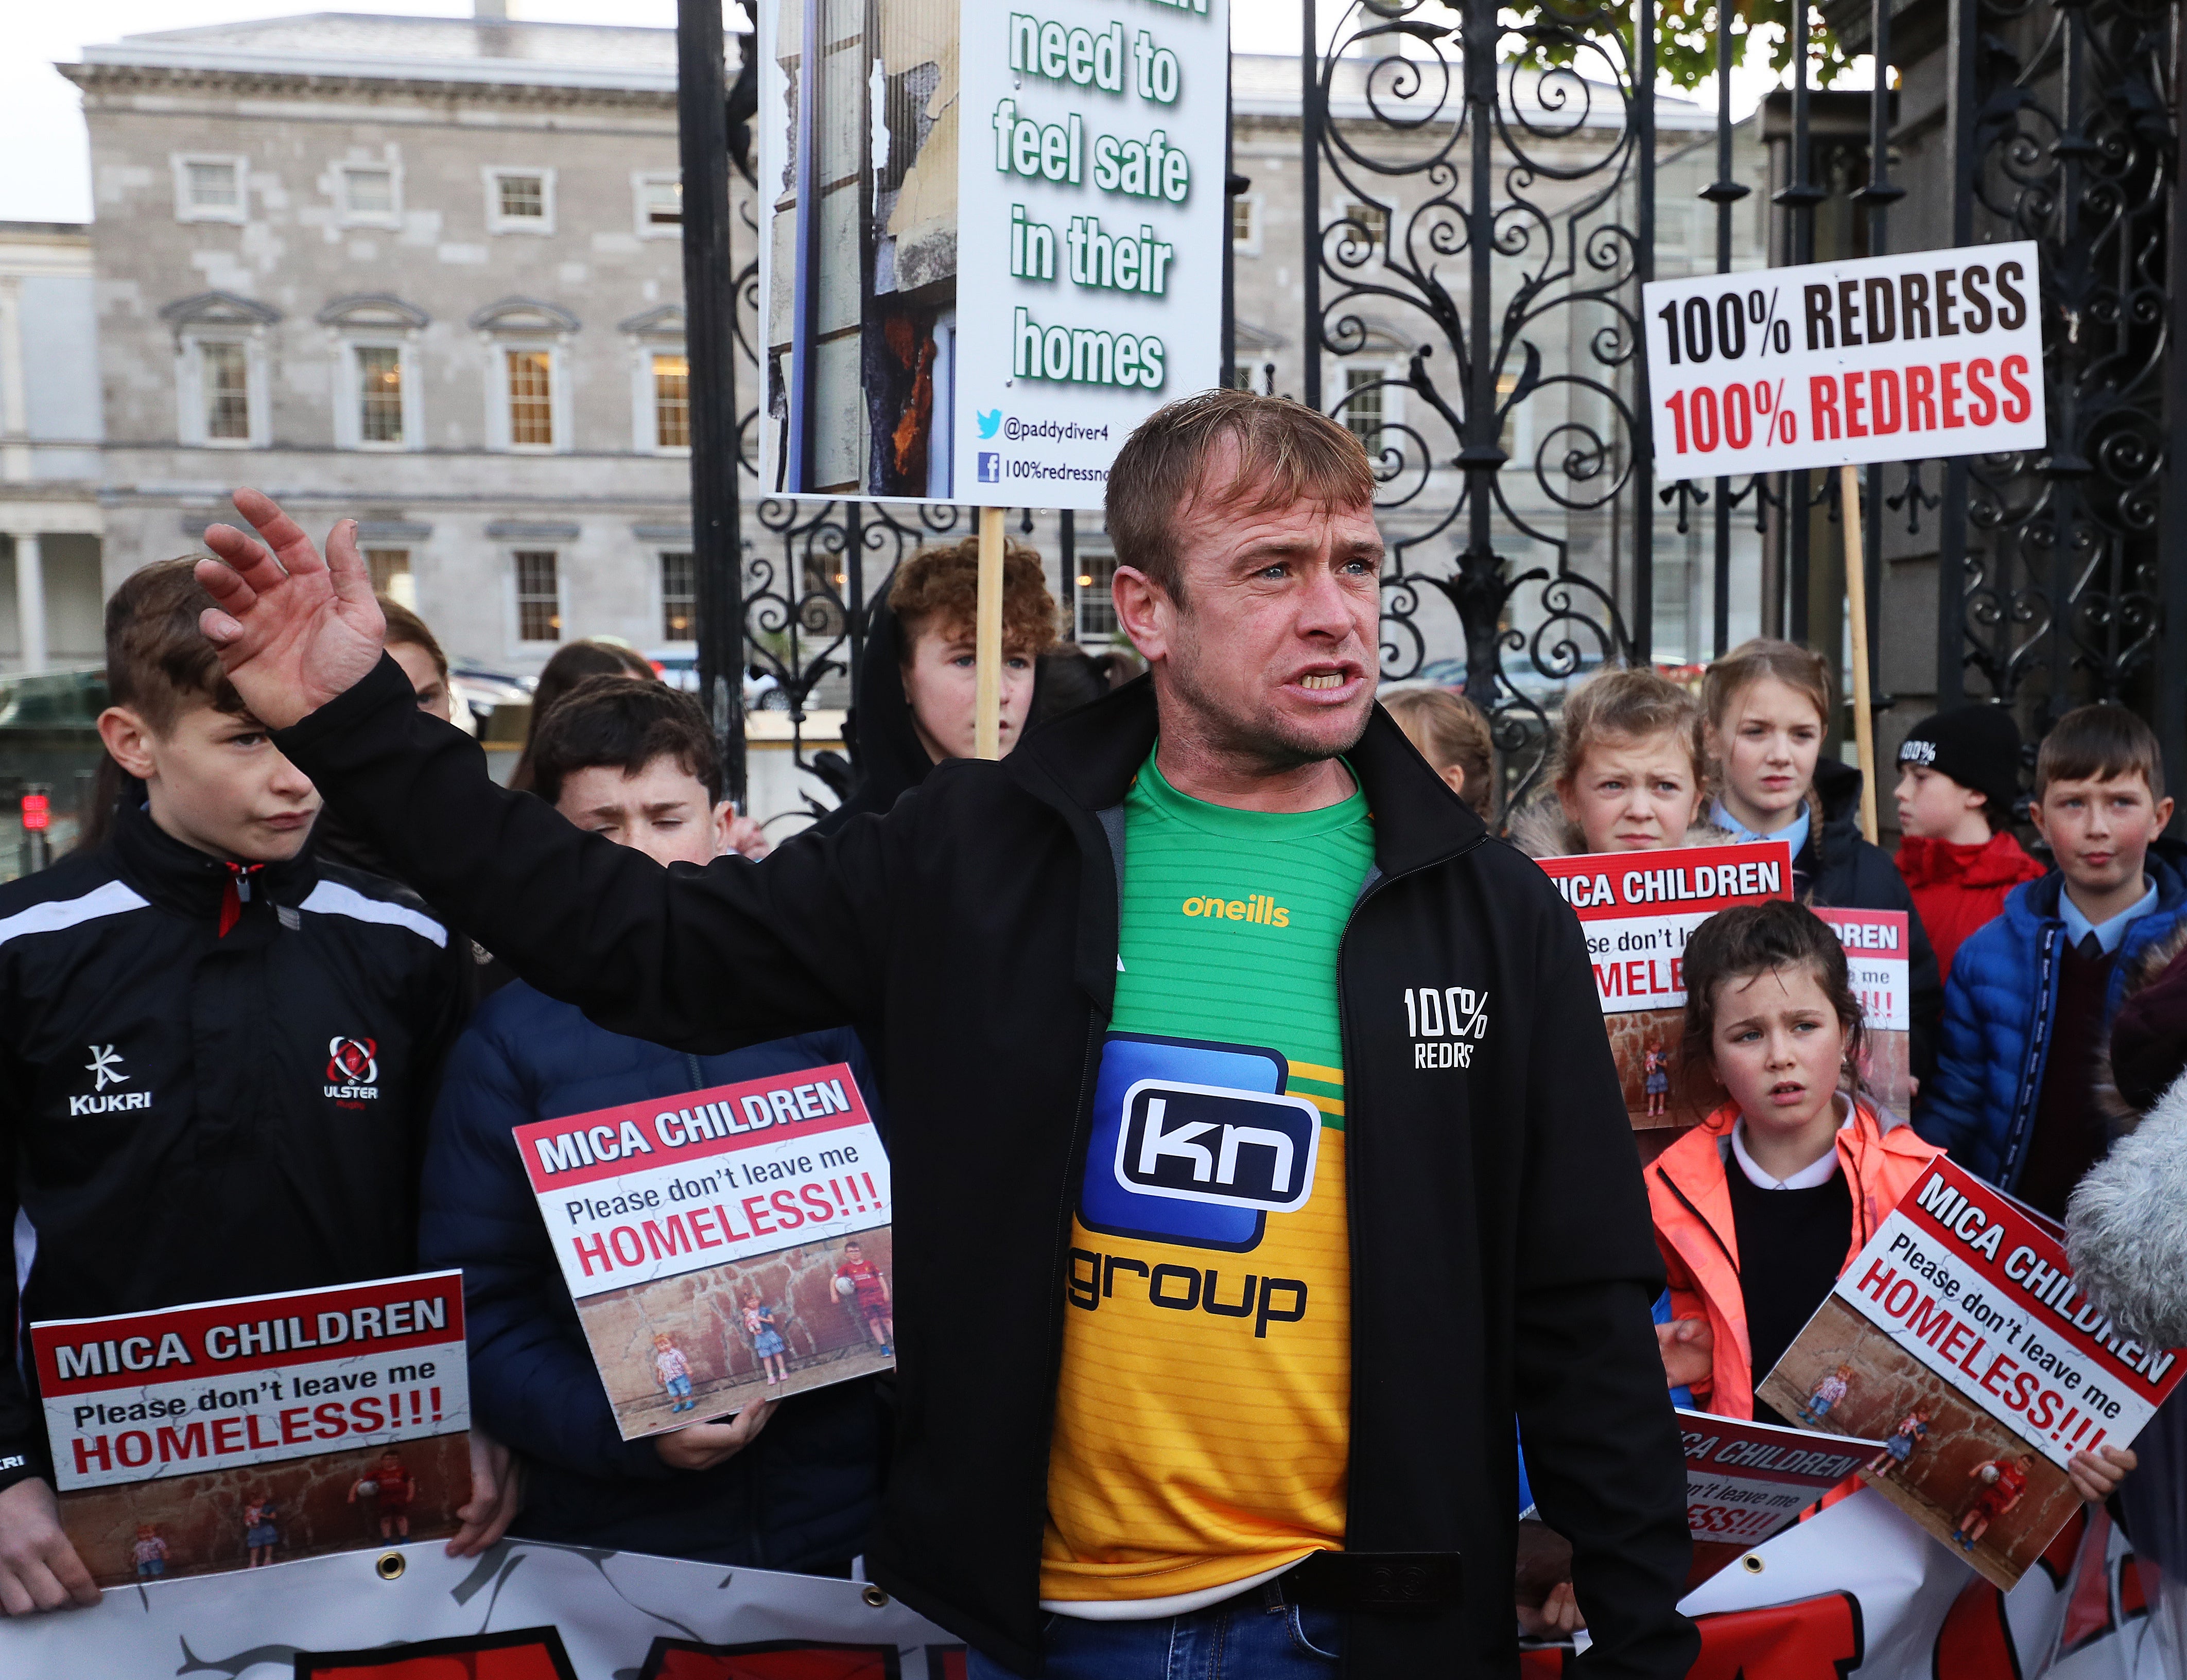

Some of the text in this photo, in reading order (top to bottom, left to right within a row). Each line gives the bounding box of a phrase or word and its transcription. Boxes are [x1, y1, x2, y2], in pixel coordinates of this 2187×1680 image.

[1010, 12, 1179, 103] need to
[994, 99, 1189, 202] feel safe
[1011, 204, 1172, 295] in their
[1014, 307, 1164, 390] homes
[1659, 261, 2026, 364] 100% REDRESS
[1004, 417, 1108, 443] @paddydiver4
[1665, 354, 2032, 454] 100% REDRESS
[1551, 861, 1780, 907] ICA CHILDREN
[1618, 929, 1673, 951] don't
[1862, 971, 1889, 984] me
[1404, 987, 1488, 1039] 100%
[69, 1091, 152, 1116] KUKRI
[324, 1085, 378, 1099] ULSTER
[534, 1079, 850, 1175] MICA CHILDREN
[566, 1146, 860, 1227] Please don't leave me
[1138, 1098, 1294, 1193] kn
[571, 1172, 883, 1277] HOMELESS!!!
[1916, 1171, 2006, 1263] MICA
[1068, 1247, 1307, 1338] group
[1890, 1233, 2121, 1420] Please don't leave me
[55, 1297, 447, 1380] MICA CHILDREN
[1856, 1258, 2107, 1454] HOMELESS!!!
[72, 1387, 444, 1474] HOMELESS!!!
[74, 1361, 436, 1428] Please don't leave me
[1681, 1431, 1861, 1478] CA CHILDREN
[1687, 1480, 1800, 1509] n't leave me
[1688, 1503, 1781, 1536] ESS!!!
